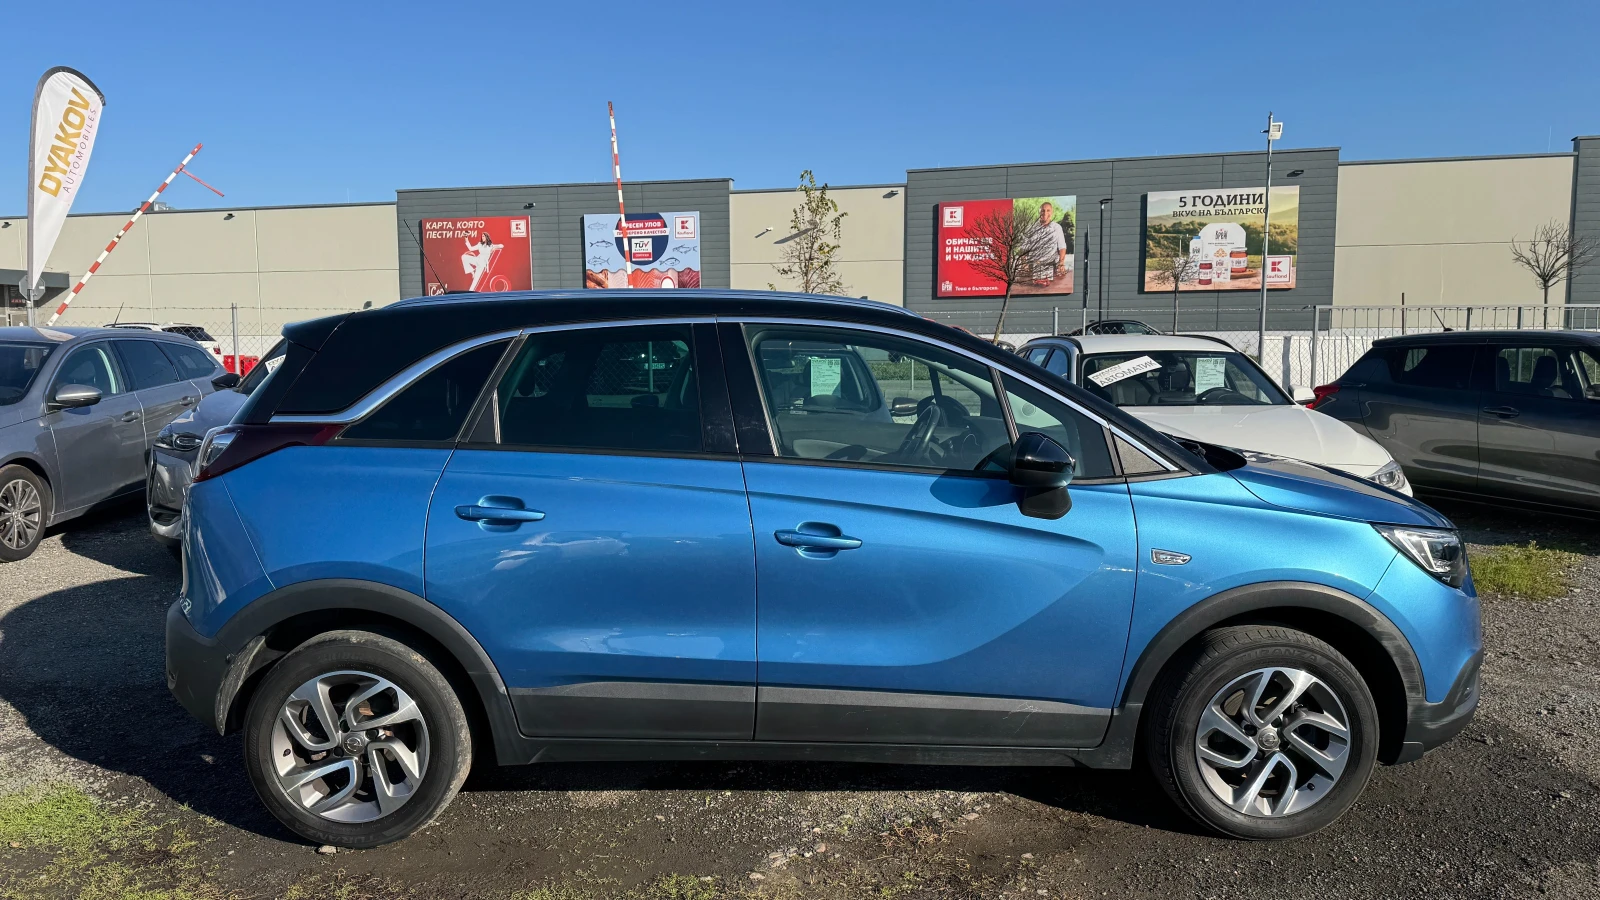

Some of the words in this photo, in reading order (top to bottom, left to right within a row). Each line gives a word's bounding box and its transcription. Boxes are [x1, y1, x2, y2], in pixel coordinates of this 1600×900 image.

[38, 87, 90, 197] DYAKOV
[62, 108, 97, 193] AUTOMOBILES
[1179, 196, 1186, 208] 5
[1191, 193, 1264, 208] ГОДИНИ
[425, 221, 455, 230] КАРТА,
[456, 220, 485, 229] КОЯТО
[426, 231, 453, 239] ПЕСТИ
[1100, 360, 1156, 386] АВТОМАТИК
